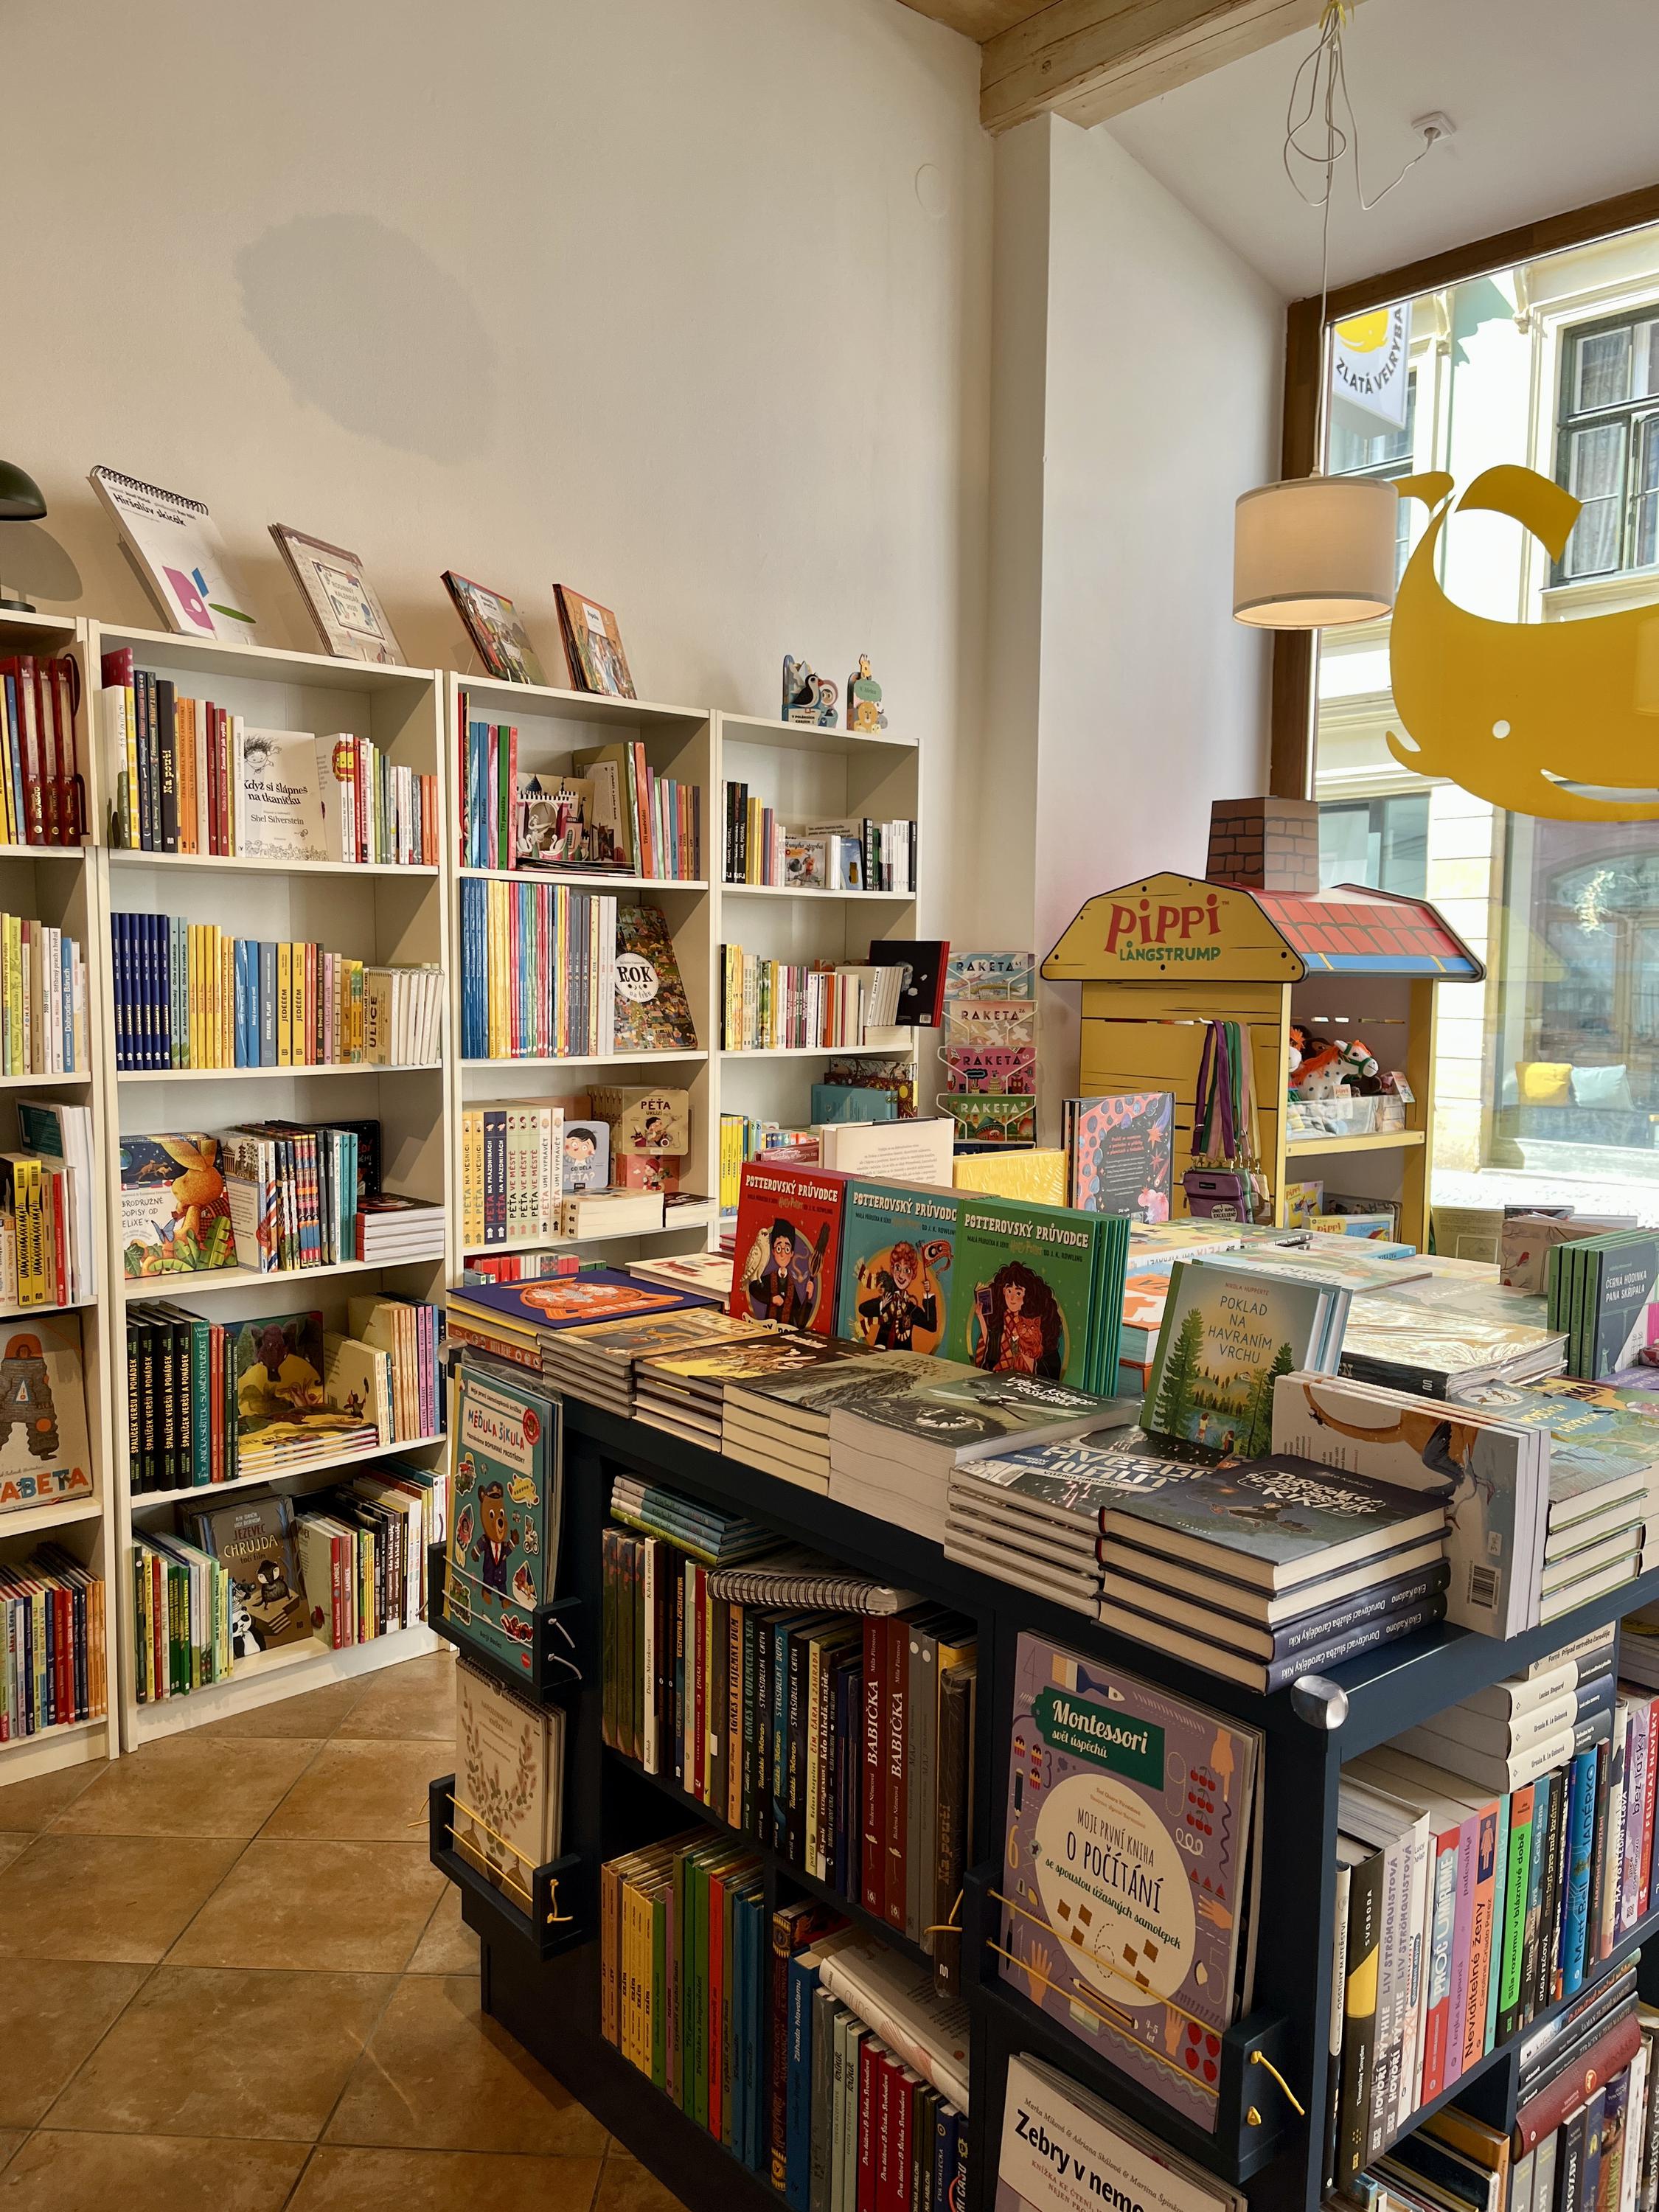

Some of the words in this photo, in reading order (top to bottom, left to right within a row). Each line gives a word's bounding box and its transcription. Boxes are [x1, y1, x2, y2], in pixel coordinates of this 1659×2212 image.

[1336, 357, 1373, 394] ZLATÁ
[1374, 308, 1402, 389] VELRYBA
[163, 779, 172, 793] Na
[262, 792, 301, 804] tkaničku
[266, 782, 274, 792] si
[276, 785, 307, 796] šlápneš
[251, 815, 266, 823] Shel
[268, 815, 304, 825] Silverstein
[1119, 940, 1221, 961] LÅNGSTRUMP
[617, 966, 653, 983] ROK
[956, 961, 1015, 972] RAKETA
[369, 995, 378, 1048] ULICE
[961, 1009, 1020, 1020] RAKETA
[963, 1054, 1022, 1065] RAKETA
[641, 1098, 671, 1111] PÉŤA
[476, 1175, 481, 1184] NA
[488, 1185, 493, 1193] NA
[510, 1181, 515, 1191] VE
[532, 1180, 538, 1189] VE
[745, 1175, 796, 1195] POTTEROVSKÝ
[798, 1181, 838, 1203] PRŮVODCE
[853, 1192, 912, 1214] POTTEROVSKÝ
[964, 1214, 1033, 1239] POTTEROVSKÝ
[1035, 1222, 1089, 1249] PRŮVODCE
[1606, 1274, 1623, 1290] ČERNÁ
[1624, 1270, 1647, 1285] HODINKA
[1220, 1295, 1267, 1316] POKLAD
[1606, 1290, 1620, 1303] PANA
[1230, 1315, 1245, 1328] NA
[1209, 1326, 1272, 1350] HAVRANÍM
[1220, 1343, 1260, 1364] VRCHU
[164, 1355, 173, 1382] POHÁDEK
[181, 1354, 189, 1385] POHÁDEK
[164, 1395, 173, 1416] VERŠŮ
[180, 1394, 189, 1415] VERŠŮ
[164, 1418, 174, 1449] ŠPALÍČEK
[180, 1416, 189, 1447] ŠPALÍČEK
[233, 1523, 266, 1542] JEZEVEC
[224, 1534, 279, 1558] CHRUJDA
[1391, 1589, 1413, 1604] Kadono
[1413, 1583, 1426, 1595] Eiko
[1332, 1614, 1352, 1627] služba
[1352, 1599, 1385, 1621] Doručovací
[1288, 1635, 1301, 1648] Kiki
[1301, 1621, 1332, 1638] čarodějky
[775, 1636, 783, 1661] DOPIS
[866, 1680, 880, 1767] BABIČKA
[889, 1692, 903, 1779] BABIČKA
[1052, 1700, 1148, 1755] Montessori
[773, 1731, 782, 1764] Tolonen
[819, 1738, 828, 1760] Kdo
[1051, 1730, 1068, 1745] svět
[1070, 1734, 1109, 1759] úspěchů
[1632, 1783, 1642, 1815] bez
[1644, 1790, 1654, 1828] FELIX
[1077, 1807, 1098, 1834] MOJE
[1100, 1819, 1126, 1850] PRVNÍ
[1127, 1835, 1155, 1867] KNIHA
[1514, 1832, 1526, 1864] době
[1067, 1831, 1077, 1861] O
[1084, 1841, 1164, 1915] POČÍTÁNÍ
[1045, 1858, 1054, 1870] se
[1055, 1863, 1091, 1893] spoustou
[1092, 1883, 1133, 1919] úžasných
[1134, 1912, 1181, 1950] samolepek
[1513, 1868, 1523, 1917] bláznivé
[1525, 1945, 1535, 1982] Milena
[1534, 1804, 1544, 1829] žena
[1364, 1888, 1373, 1947] SVOBODA
[1382, 1857, 1399, 1969] STRÖMQUISTOVÁ
[1466, 1902, 1483, 1946] ženy
[1573, 1916, 1585, 1964] Matt
[1579, 1881, 1588, 1913] Bell
[1509, 1930, 1520, 1975] rozumu
[1539, 1934, 1550, 1974] FEČOVÁ
[1430, 1944, 1450, 1993] PROČ
[1382, 1972, 1391, 1994] LIV
[1507, 1978, 1517, 1999] Síla
[1538, 1976, 1546, 2001] OLGA
[793, 1979, 801, 2026] hlavolamu
[1463, 1952, 1481, 2059] Neviditelné
[793, 2028, 801, 2062] Záhada
[1358, 2044, 1366, 2073] Snyder
[1356, 2075, 1364, 2106] Timothy
[1015, 2109, 1070, 2174] Zebry
[1074, 2160, 1085, 2181] v
[1024, 2098, 1043, 2116] Marka
[1043, 2113, 1065, 2133] Míková
[1073, 2135, 1096, 2157] Adriana
[1098, 2152, 1121, 2174] Skálová
[1130, 2175, 1156, 2198] Martina
[1032, 2160, 1057, 2184] KNÍŽKA
[1060, 2181, 1068, 2191] KE
[1048, 2183, 1070, 2203] NEJEN
